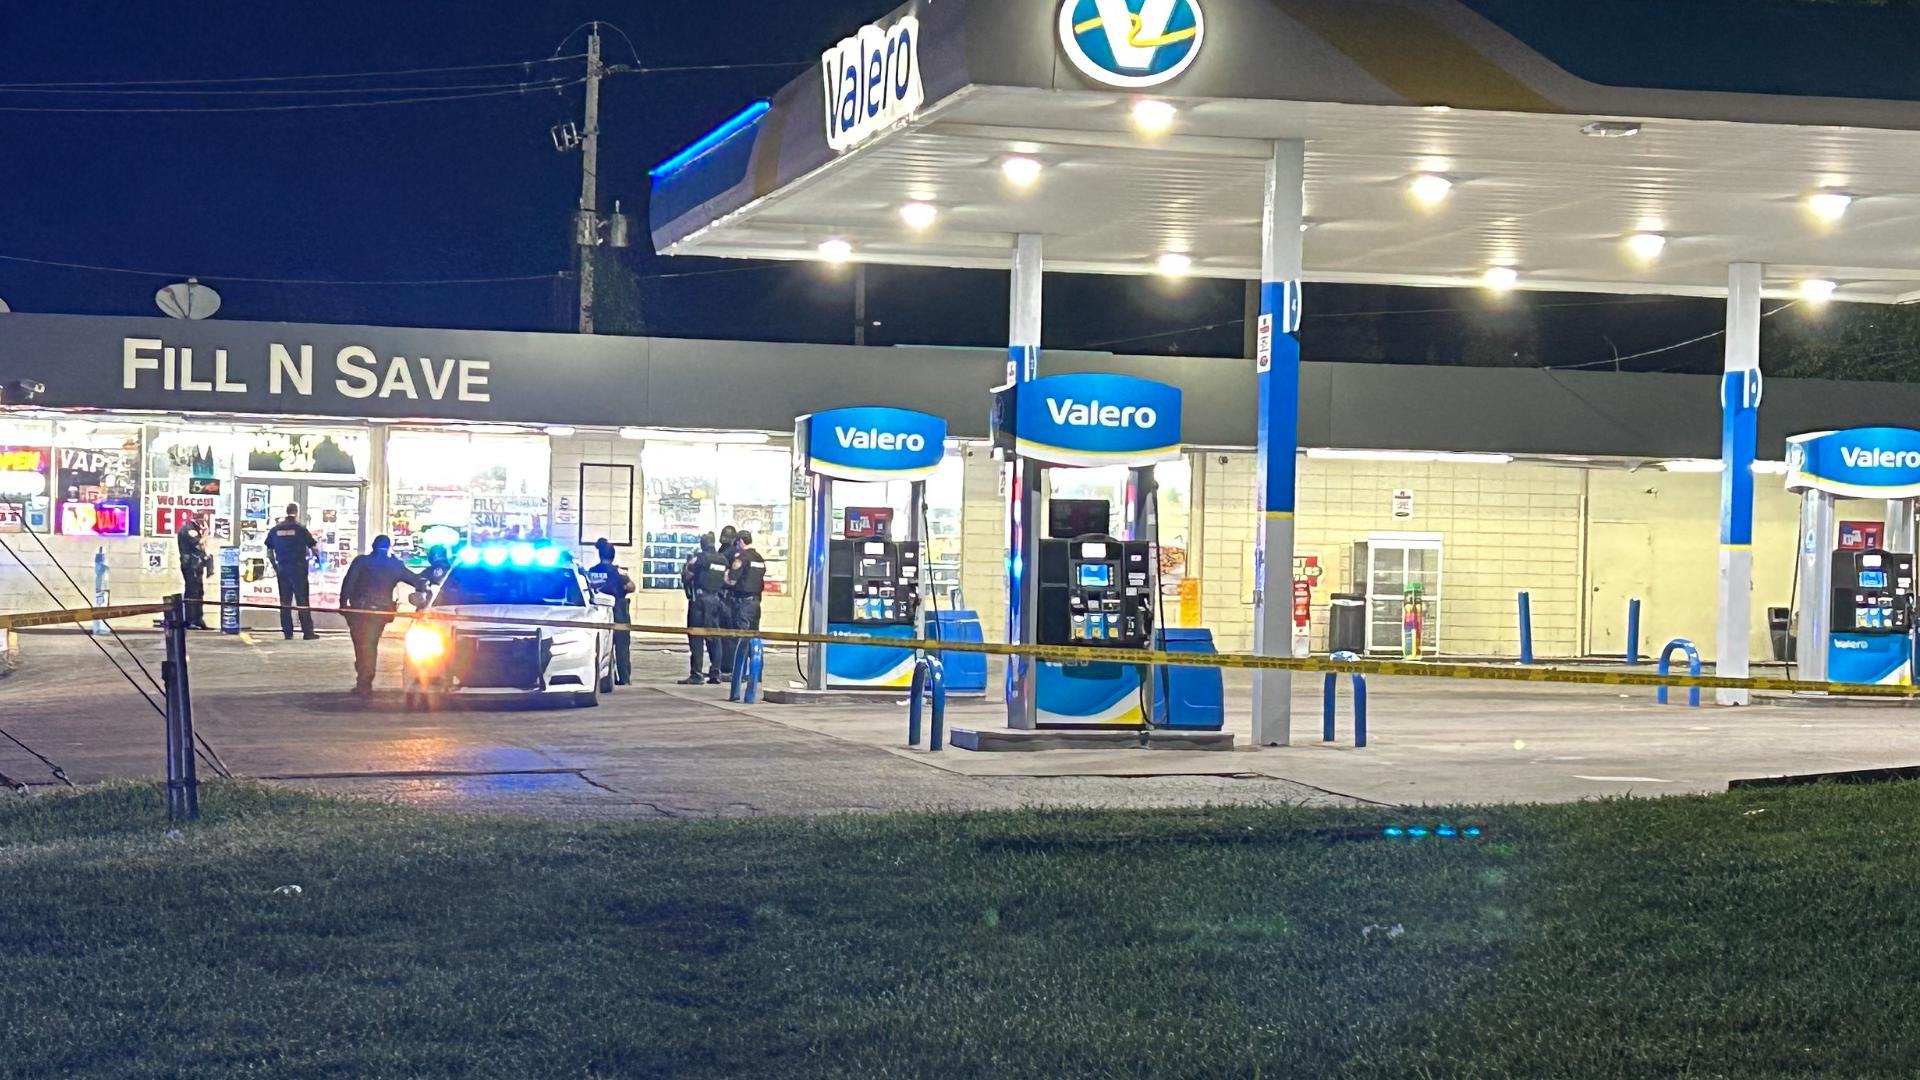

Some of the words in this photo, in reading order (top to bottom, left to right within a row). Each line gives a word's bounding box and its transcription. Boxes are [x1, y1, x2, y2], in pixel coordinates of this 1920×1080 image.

[826, 28, 912, 140] Valero
[269, 343, 313, 396] N
[1046, 397, 1157, 429] Valero
[834, 426, 926, 452] Valero
[1840, 446, 1920, 469] Valero
